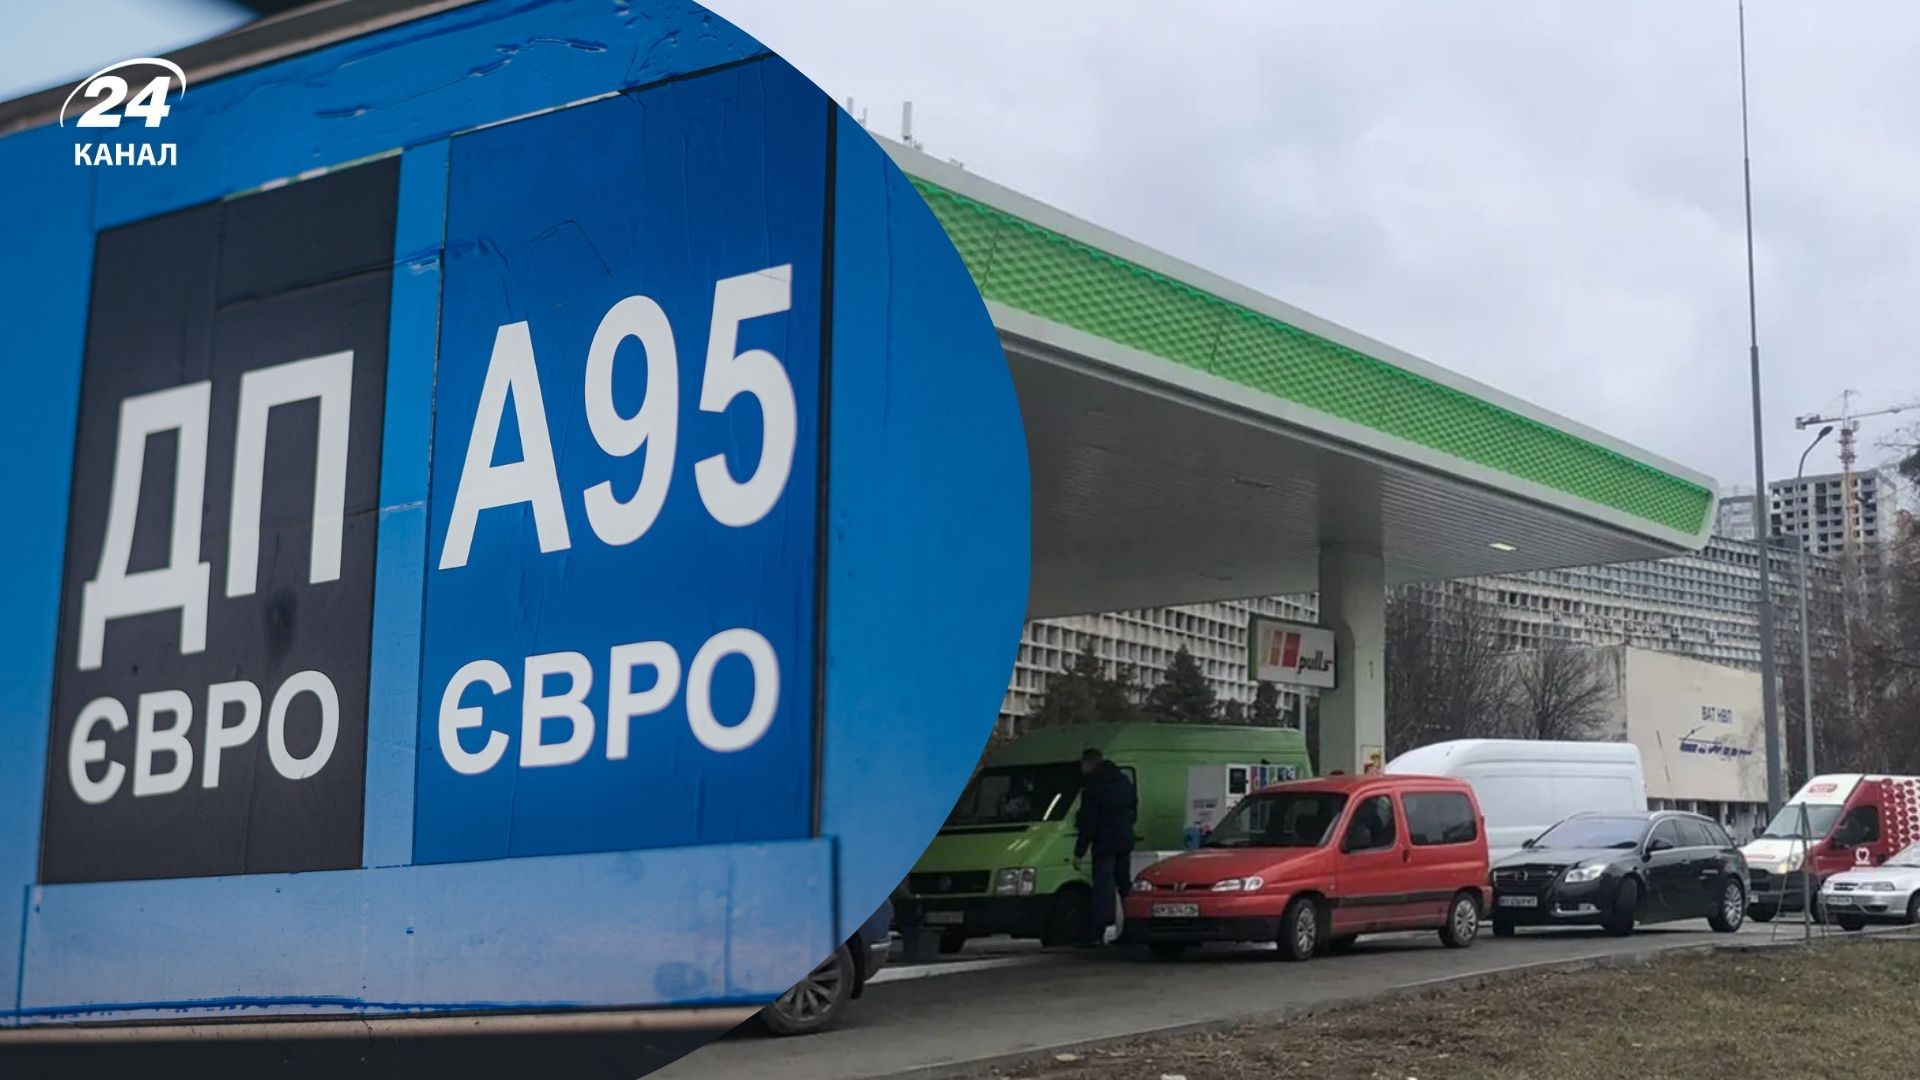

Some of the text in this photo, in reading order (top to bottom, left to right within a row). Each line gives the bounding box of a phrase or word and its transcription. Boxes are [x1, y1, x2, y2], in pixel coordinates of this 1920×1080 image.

[77, 350, 355, 672] ДП
[438, 263, 797, 571] А95
[68, 669, 341, 804] ЄВРО
[437, 627, 779, 775] ЄВРО
